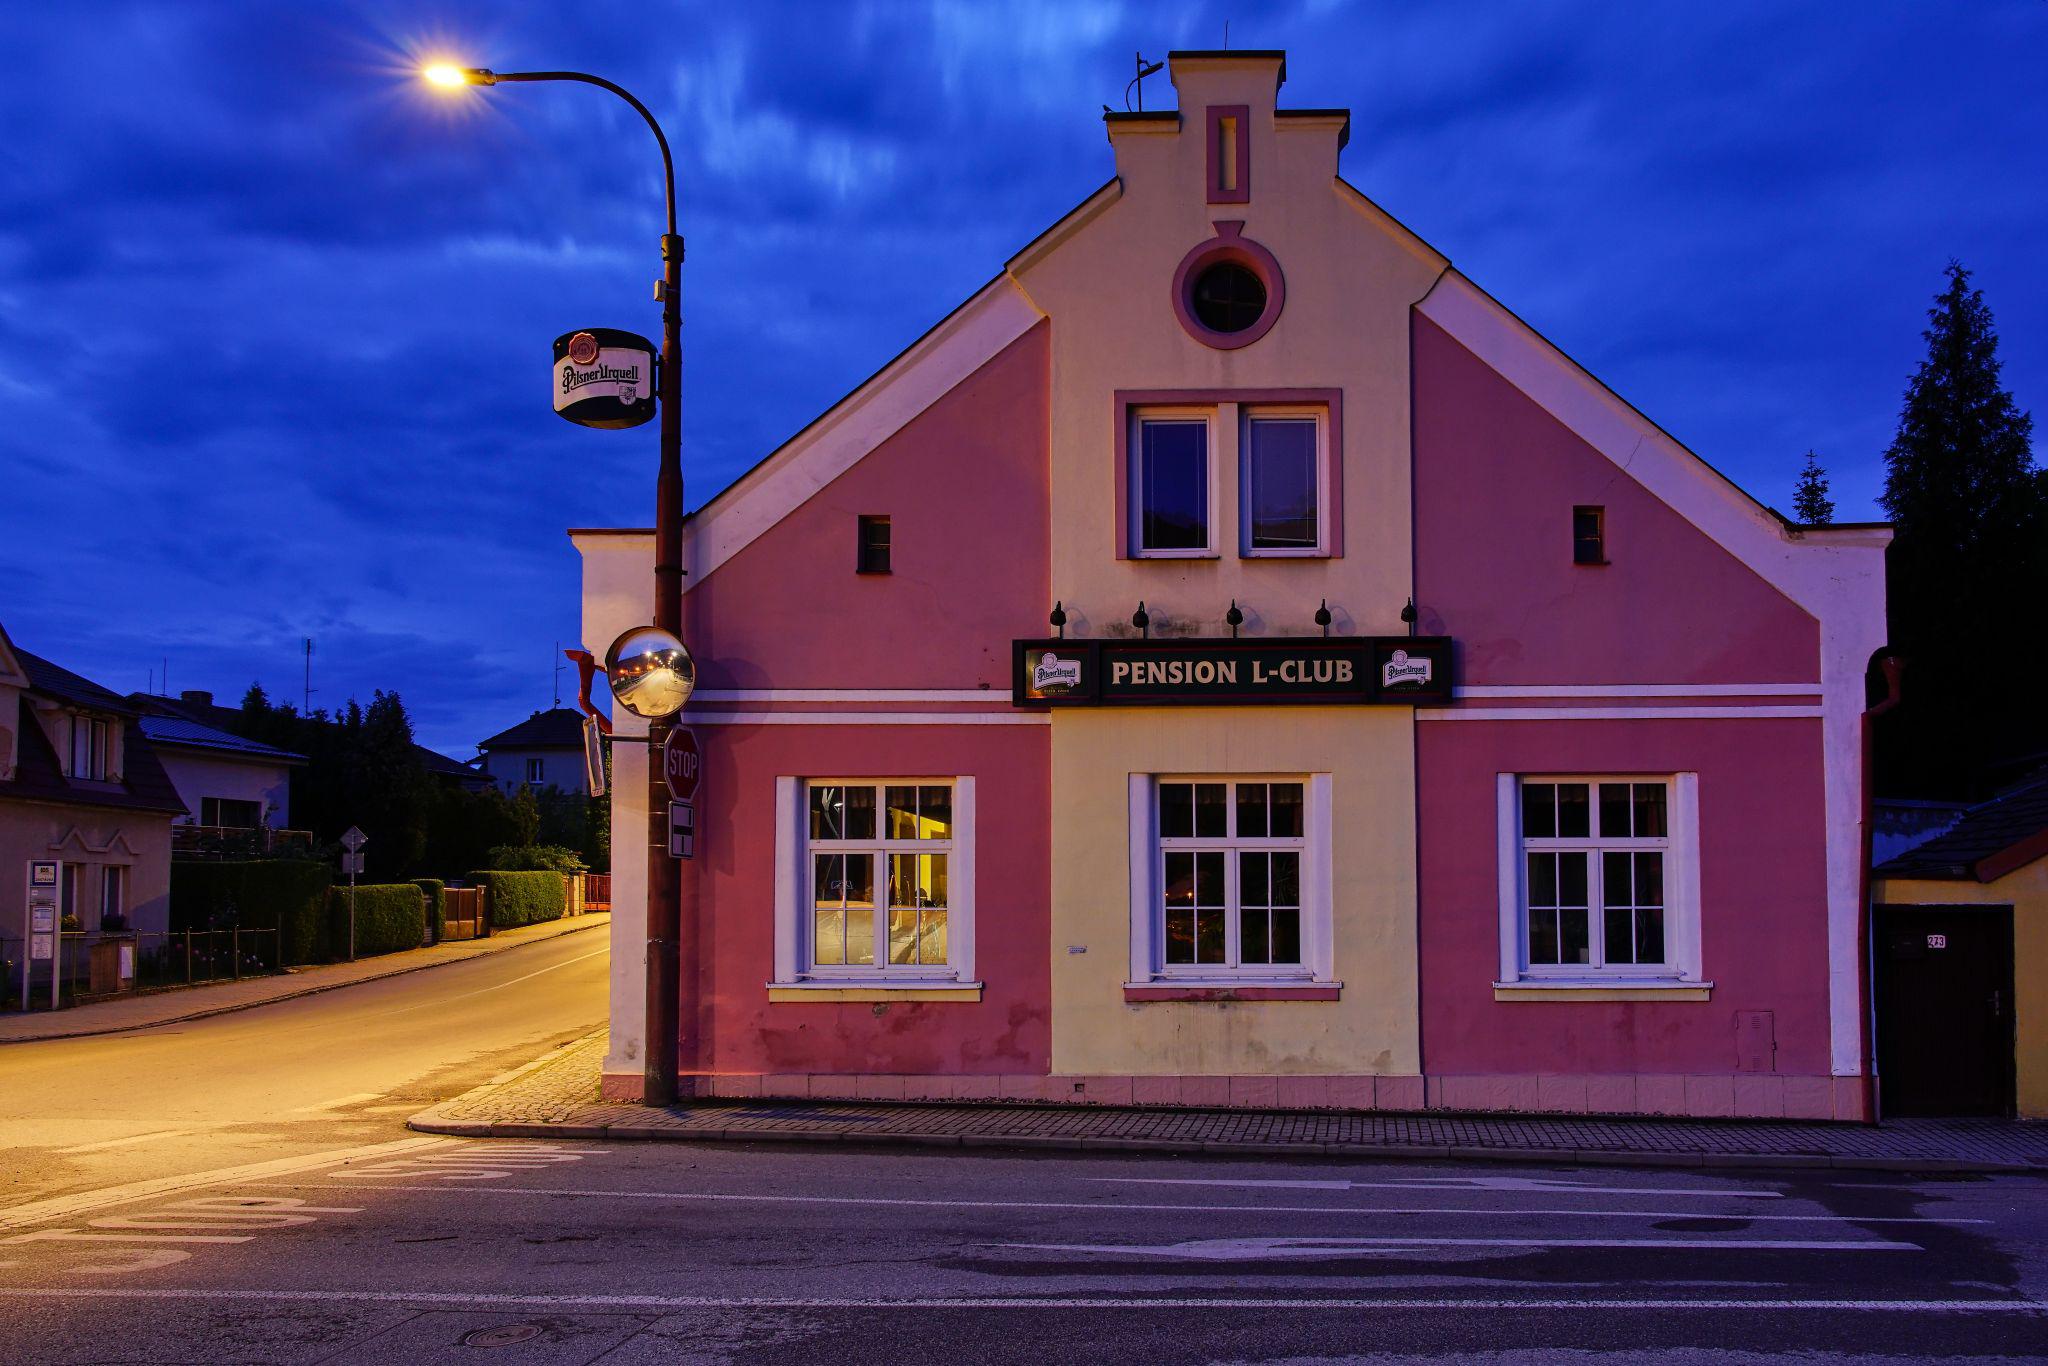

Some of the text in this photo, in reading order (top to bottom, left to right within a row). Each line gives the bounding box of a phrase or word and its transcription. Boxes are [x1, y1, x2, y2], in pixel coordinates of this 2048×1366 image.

[563, 363, 638, 394] Pilsner Urquell
[1112, 660, 1353, 684] PENSION L-CLUB
[670, 748, 698, 779] STOP
[1928, 936, 1944, 948] 273
[327, 1145, 612, 1180] STOP
